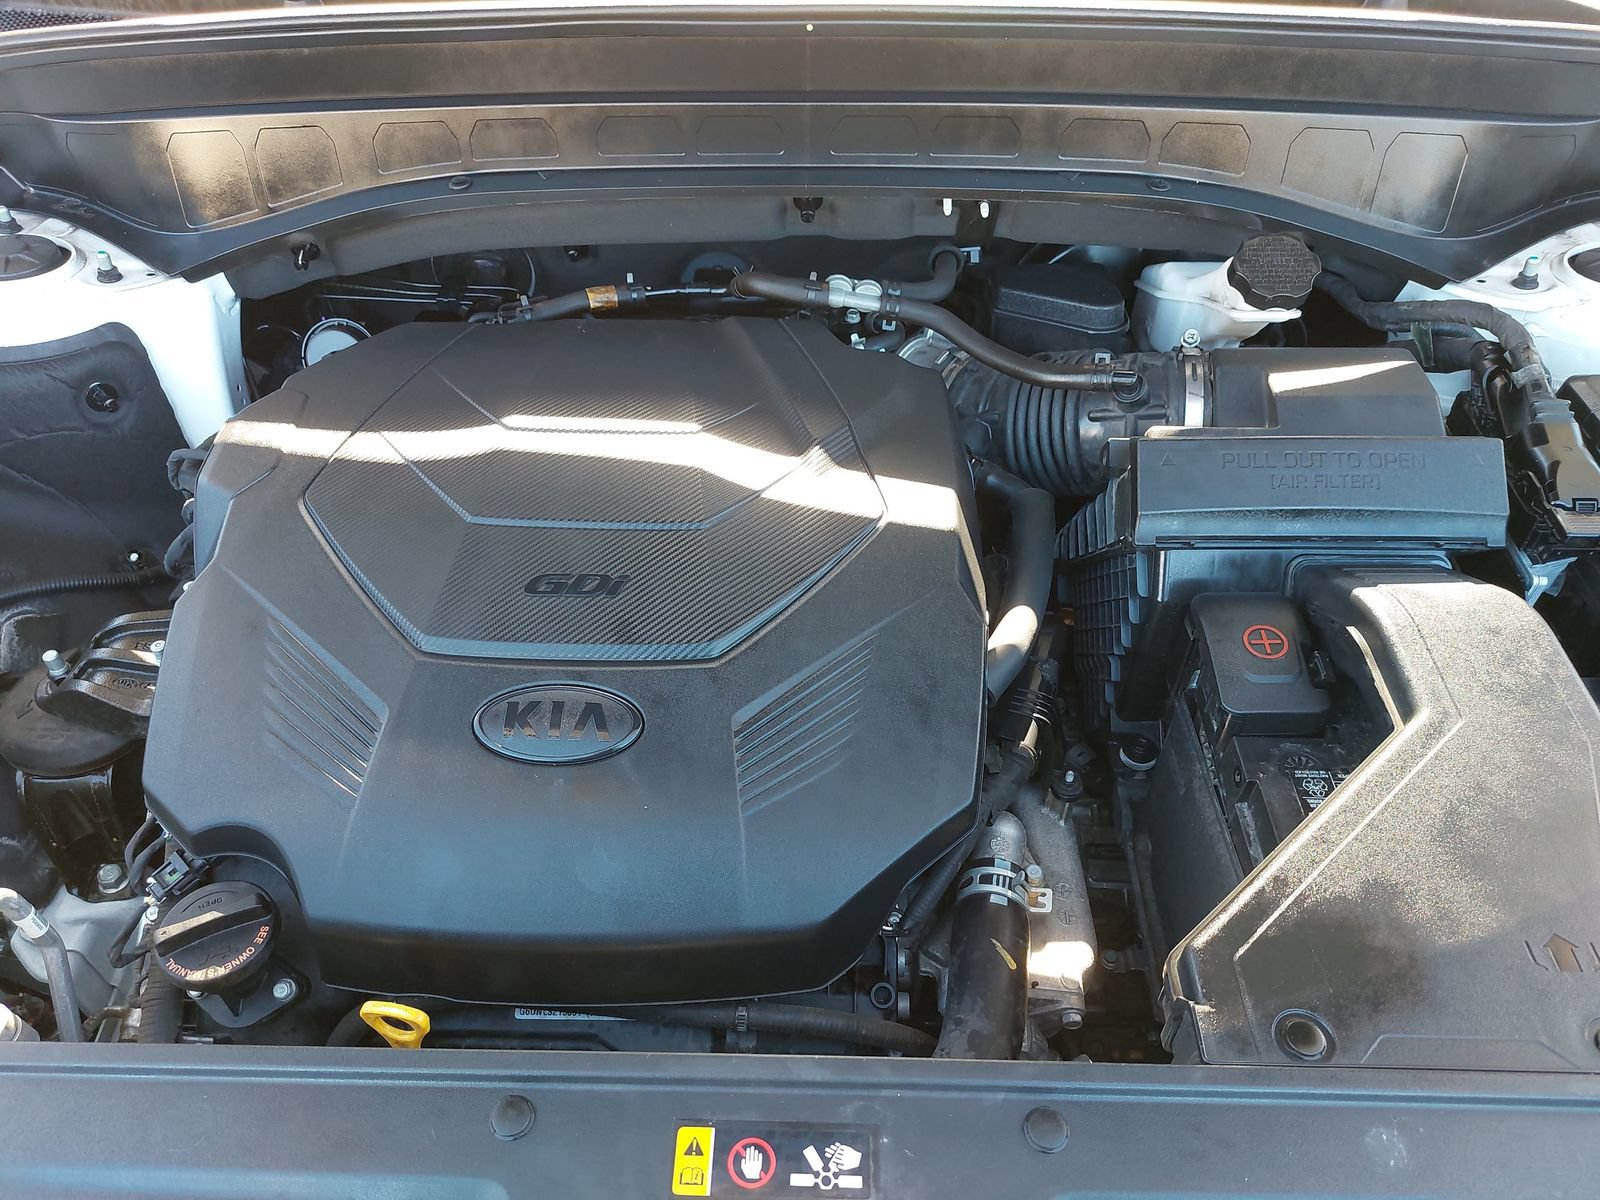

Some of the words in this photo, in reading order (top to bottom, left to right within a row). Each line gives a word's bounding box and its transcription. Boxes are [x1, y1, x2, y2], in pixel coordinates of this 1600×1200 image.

[1221, 451, 1277, 469] PULL
[1284, 451, 1328, 469] OUT
[1332, 451, 1361, 469] TO
[1369, 452, 1426, 469] OPEN
[524, 573, 631, 597] GDi
[503, 700, 612, 742] KIA
[198, 897, 223, 911] OPEN
[254, 925, 270, 945] SEE
[165, 957, 204, 980] MANUAL
[207, 946, 255, 977] OWNER'S
